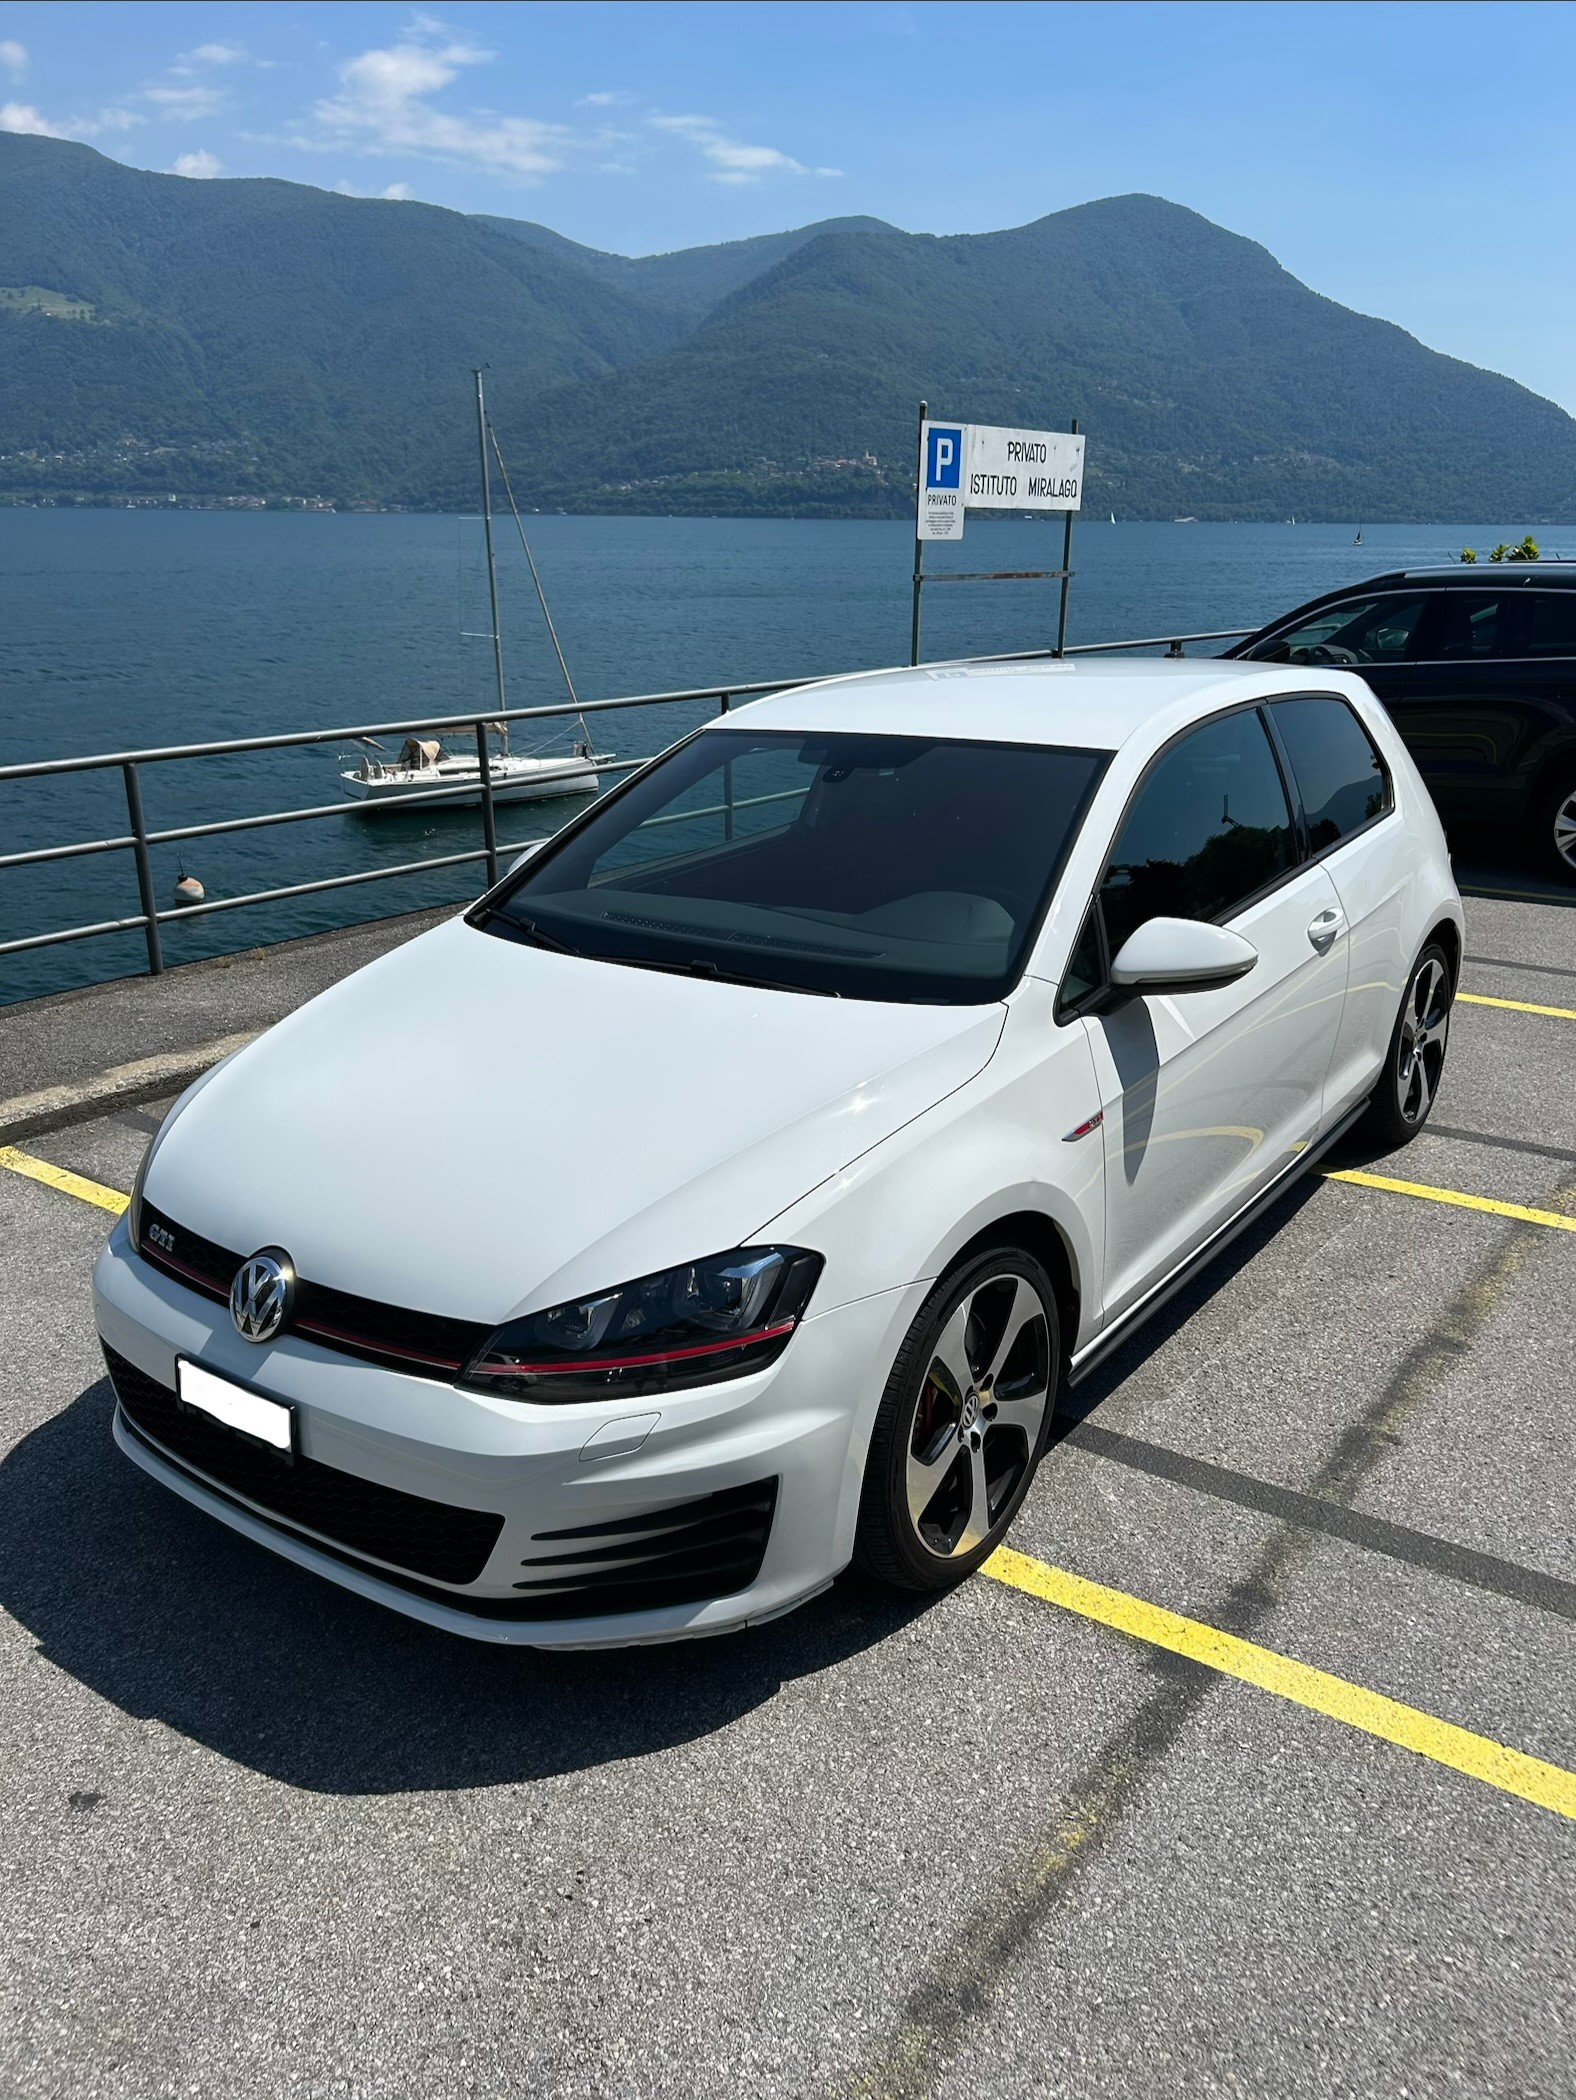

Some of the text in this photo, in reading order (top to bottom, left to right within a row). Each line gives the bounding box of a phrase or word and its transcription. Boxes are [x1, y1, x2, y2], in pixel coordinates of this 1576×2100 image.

[936, 438, 953, 481] P
[1007, 441, 1047, 463] PRIVATO
[970, 473, 1078, 498] ISTITUTO MIRALAGO
[927, 494, 957, 506] PRIVATO
[149, 1223, 176, 1252] GTI
[232, 1259, 287, 1340] VW
